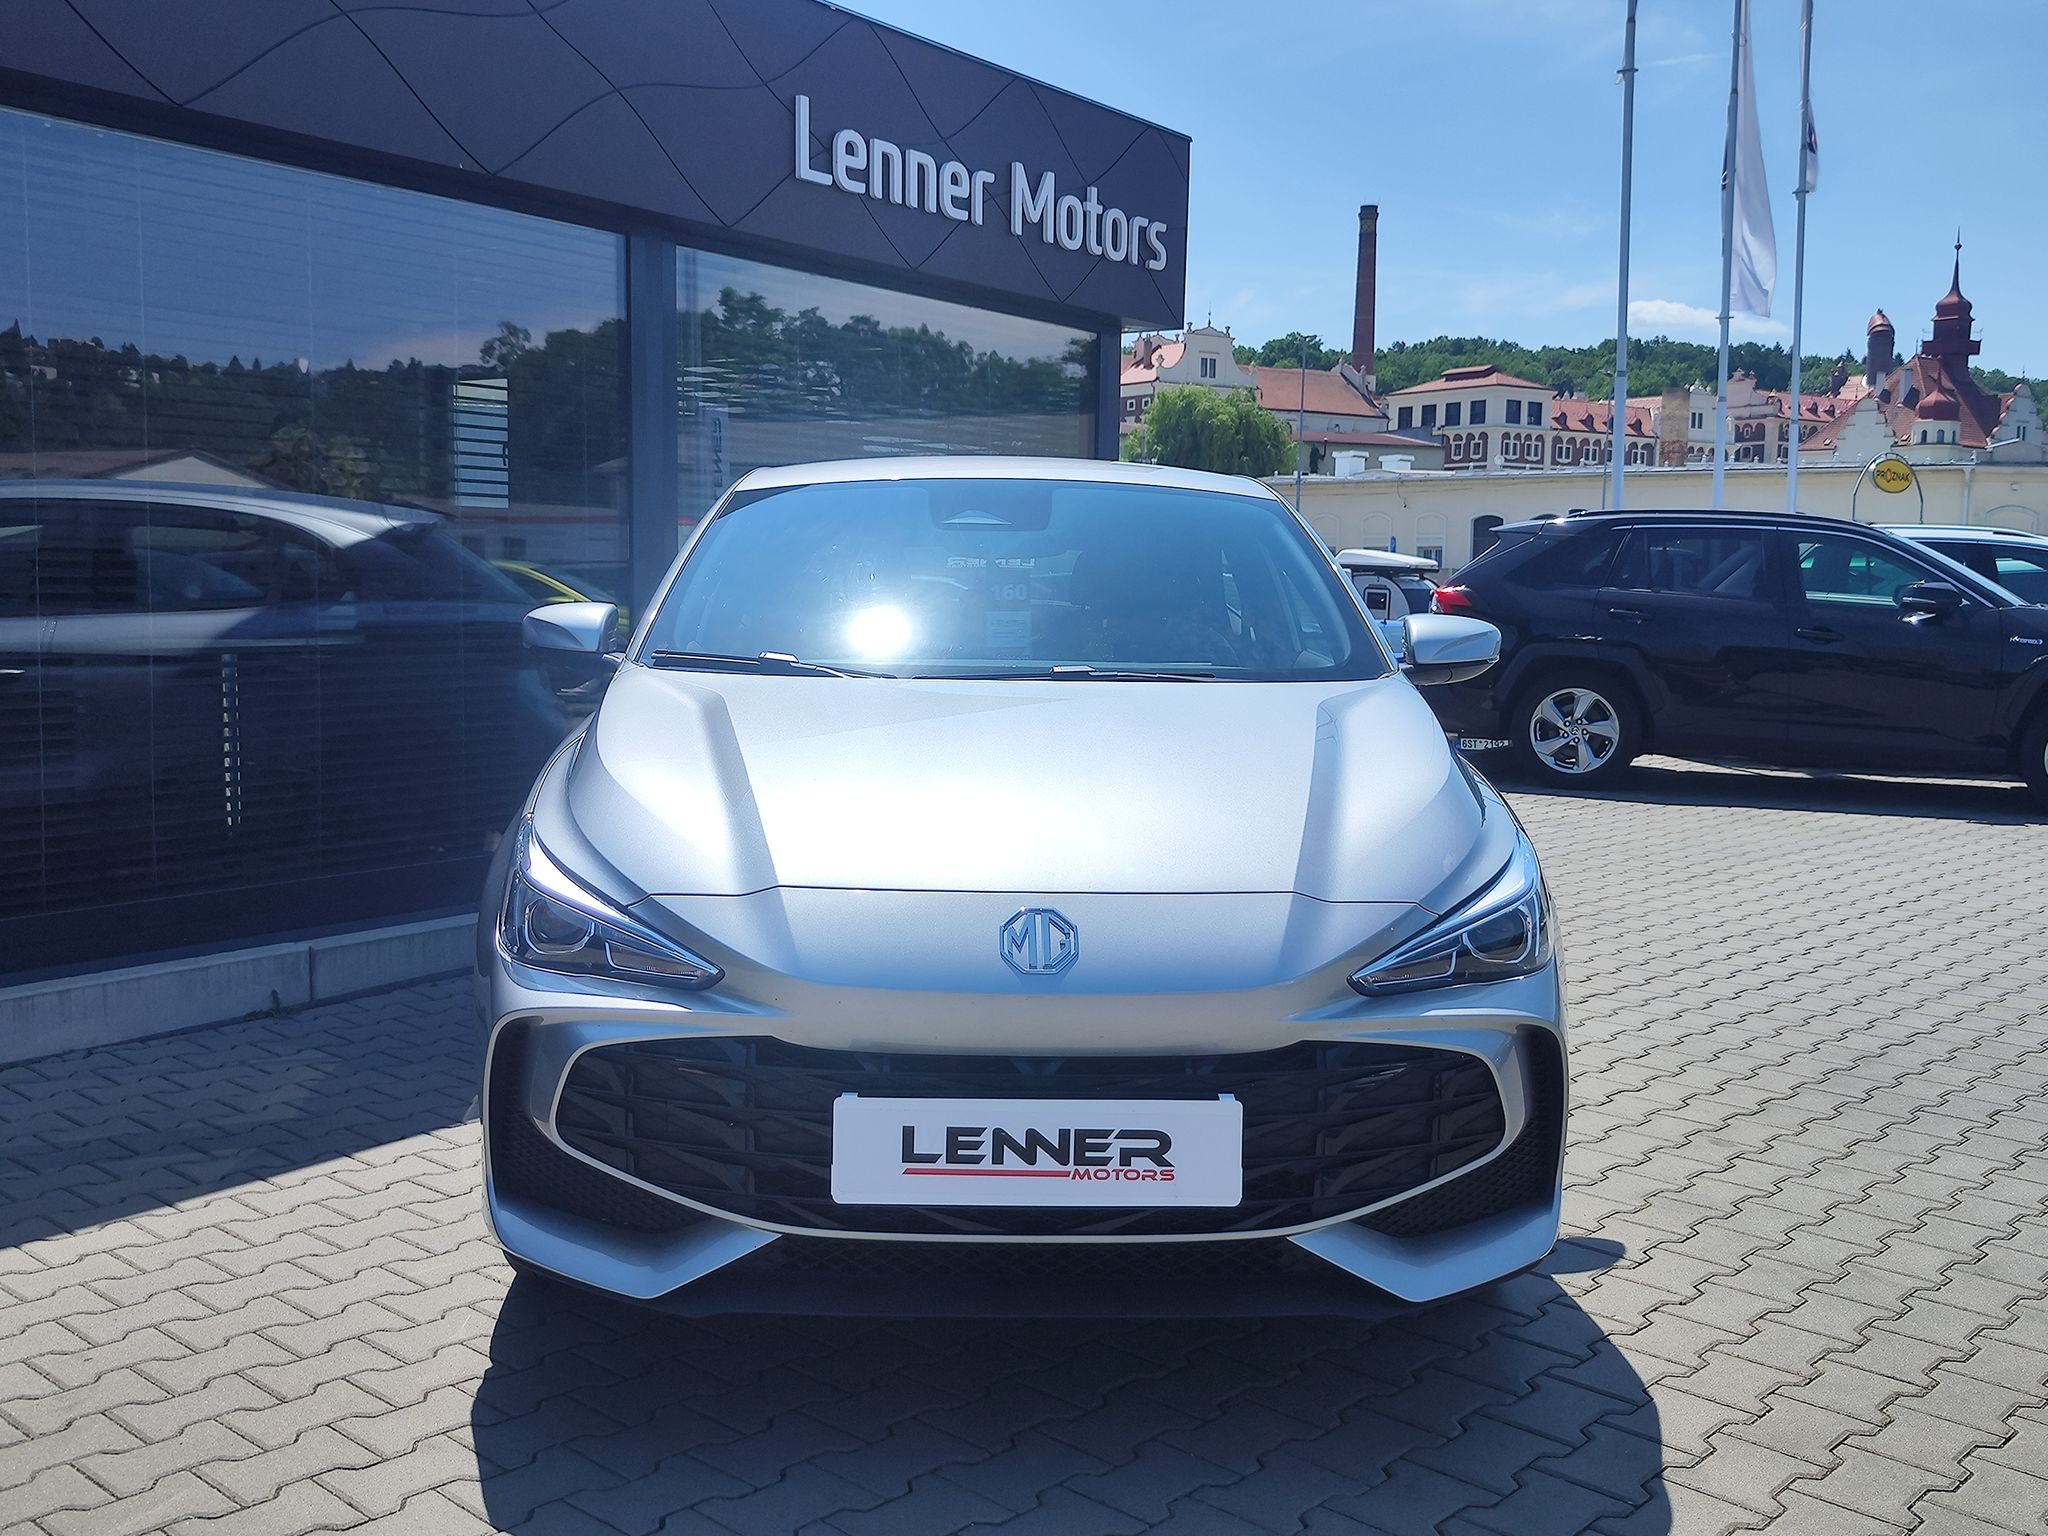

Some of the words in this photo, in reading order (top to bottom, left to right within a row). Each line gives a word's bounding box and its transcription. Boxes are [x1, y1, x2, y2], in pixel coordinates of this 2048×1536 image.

[795, 94, 994, 226] Lenner
[1010, 161, 1168, 271] Motors
[1462, 739, 1477, 748] 6ST
[1007, 912, 1071, 968] MG
[902, 1125, 1175, 1167] LENNER
[1071, 1168, 1175, 1181] MOTORS
